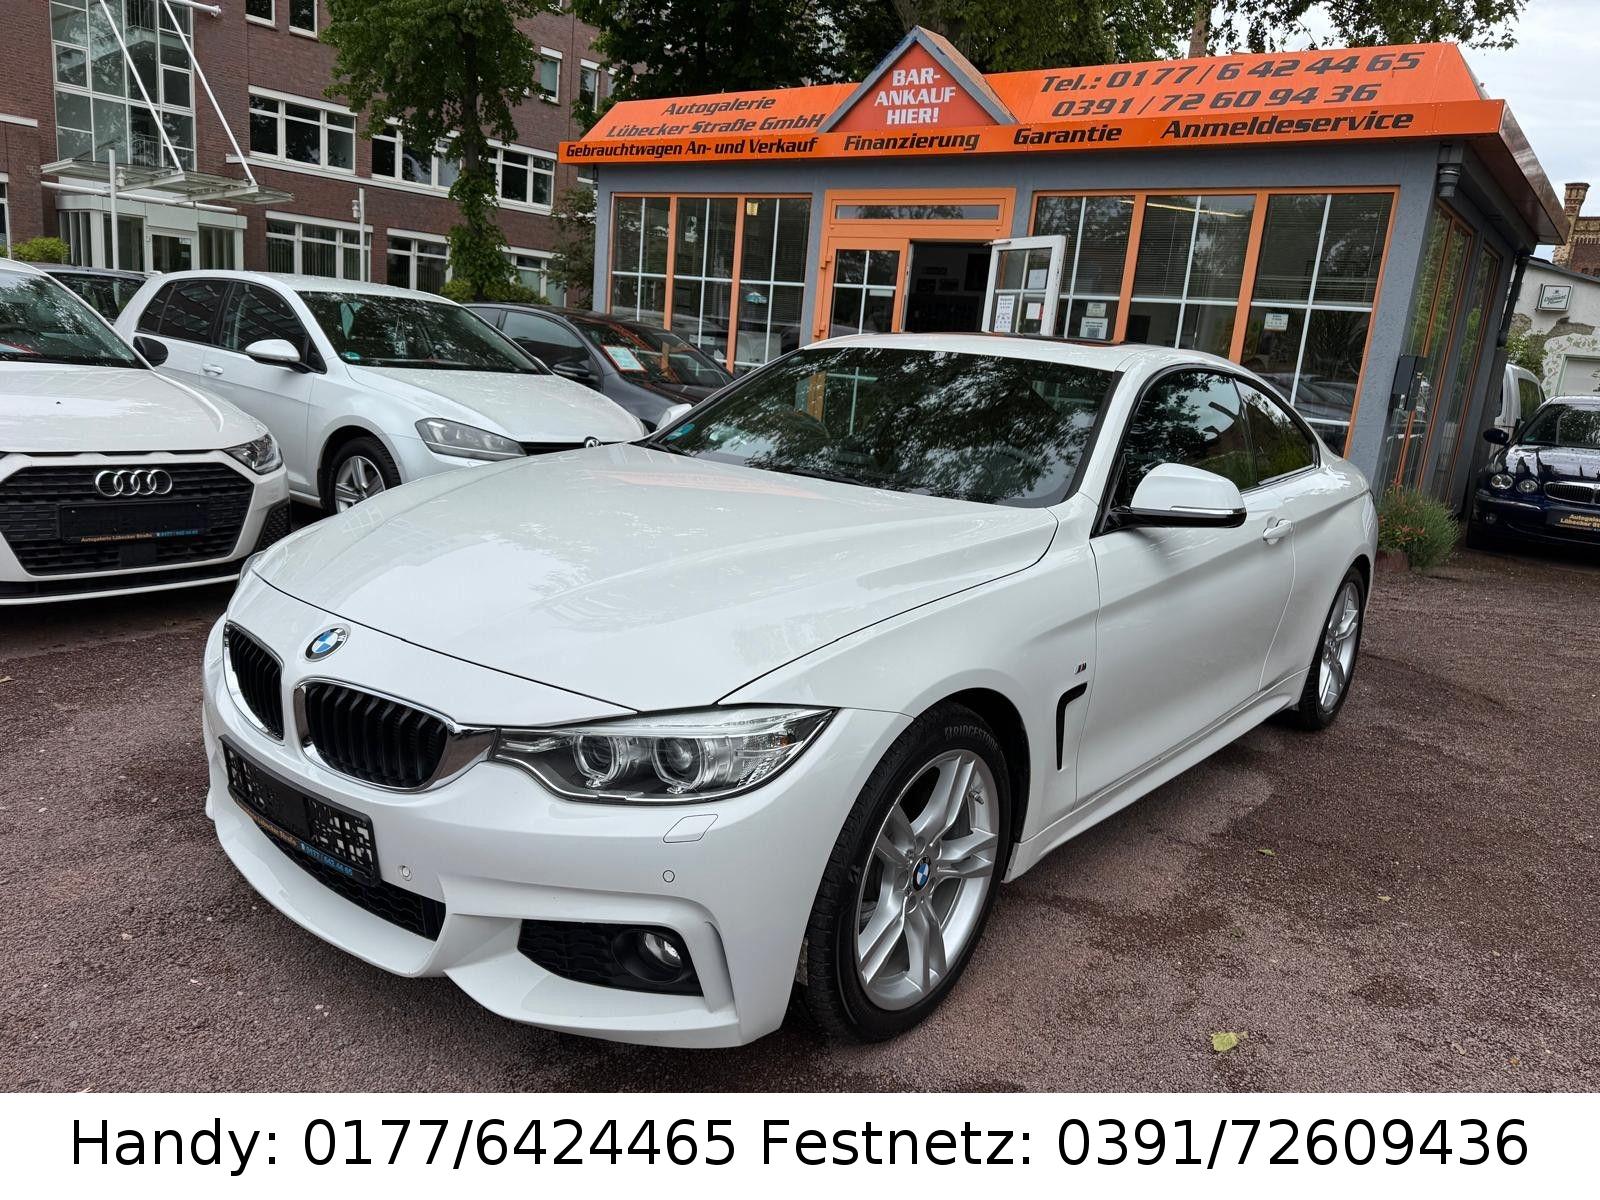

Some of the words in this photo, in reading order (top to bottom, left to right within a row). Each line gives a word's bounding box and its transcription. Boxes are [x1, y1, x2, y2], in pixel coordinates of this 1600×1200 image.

[892, 67, 941, 86] BAR-
[1041, 73, 1101, 92] Tel.:
[1106, 65, 1199, 89] 0177
[1247, 59, 1301, 78] 42
[1304, 55, 1361, 74] 44
[1366, 51, 1426, 72] 65
[661, 96, 777, 116] Autogalerie
[874, 87, 956, 106] ANKAUF
[1051, 97, 1135, 118] 0391
[1159, 93, 1206, 112] 72
[1209, 90, 1262, 109] 60
[1264, 86, 1320, 106] 94
[1324, 83, 1382, 103] 36
[606, 122, 690, 138] Lübecker
[688, 118, 757, 134] Straße
[759, 113, 827, 131] GmbH
[886, 107, 939, 125] HIER!
[1159, 110, 1415, 139] Anmeldeservice
[843, 132, 980, 151] Finanzierung
[1013, 123, 1123, 145] Garantie
[566, 142, 683, 158] Gebrauchtwagen
[685, 140, 712, 155] An-
[714, 139, 745, 154] und
[749, 137, 819, 153] Verkauf
